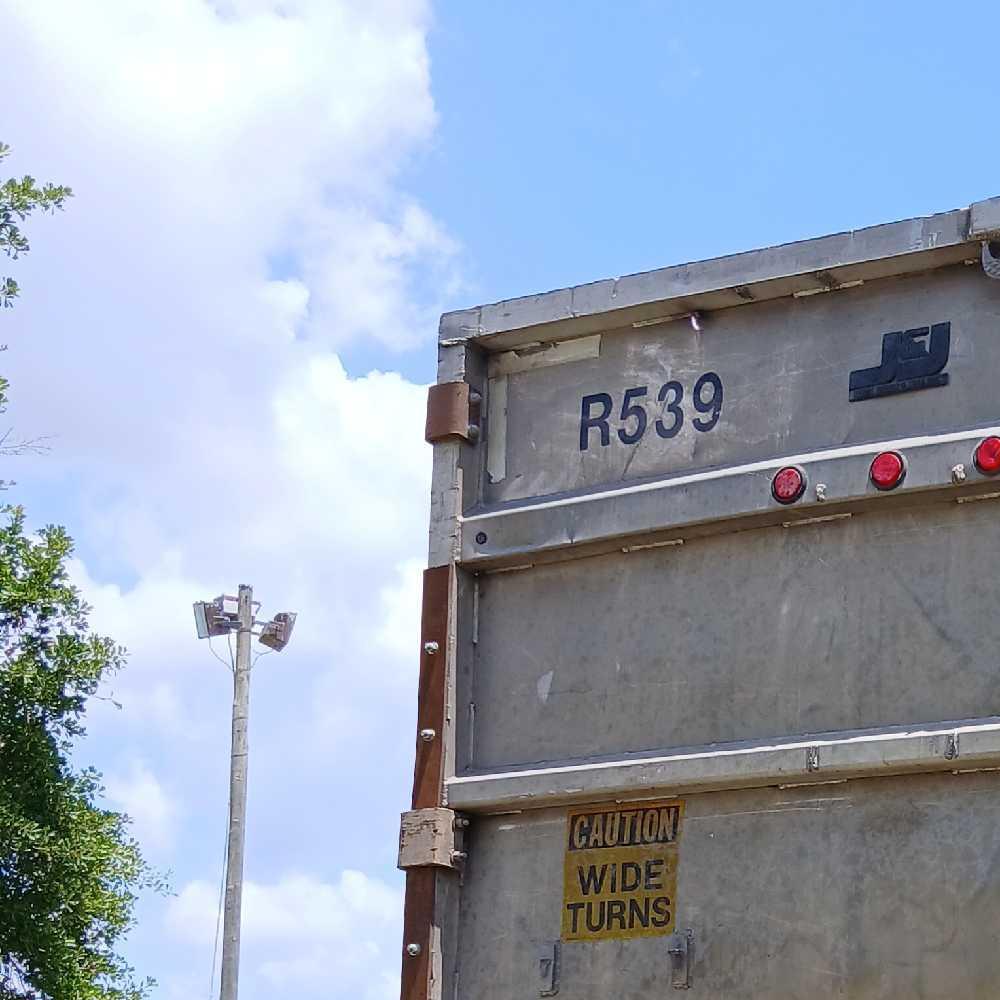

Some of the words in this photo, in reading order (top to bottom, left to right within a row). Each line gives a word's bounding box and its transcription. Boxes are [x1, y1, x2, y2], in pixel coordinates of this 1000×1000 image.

[579, 372, 724, 451] R539
[573, 807, 676, 849] CAUTION
[578, 859, 664, 895] WIDE
[566, 896, 671, 933] TURNS
